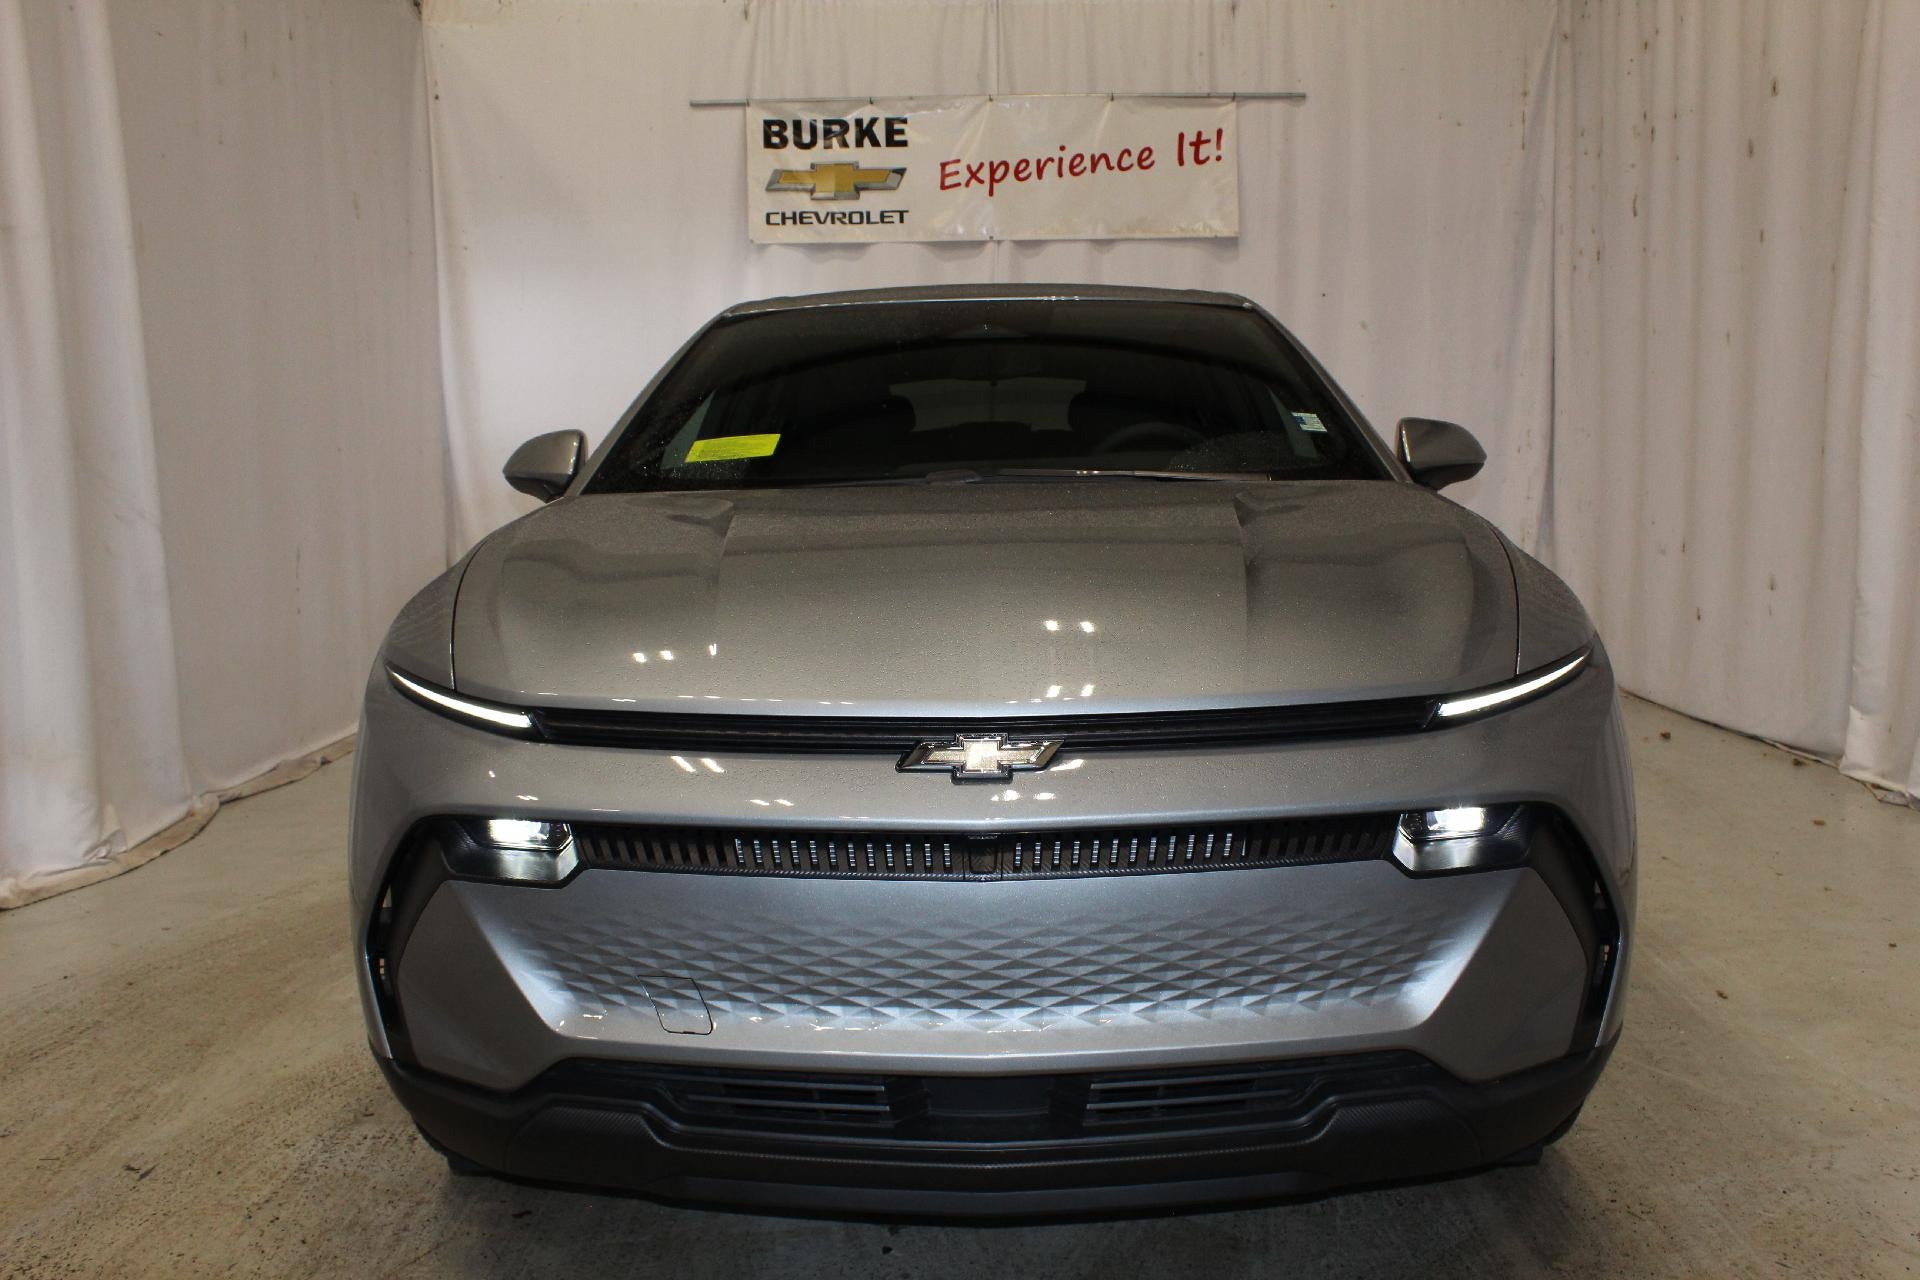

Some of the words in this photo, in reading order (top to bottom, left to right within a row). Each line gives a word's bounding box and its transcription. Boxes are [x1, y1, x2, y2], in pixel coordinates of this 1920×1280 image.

[763, 117, 909, 149] BURKE
[939, 145, 1155, 197] Experience
[1176, 128, 1224, 167] It!
[766, 209, 909, 226] CHEVROLET
